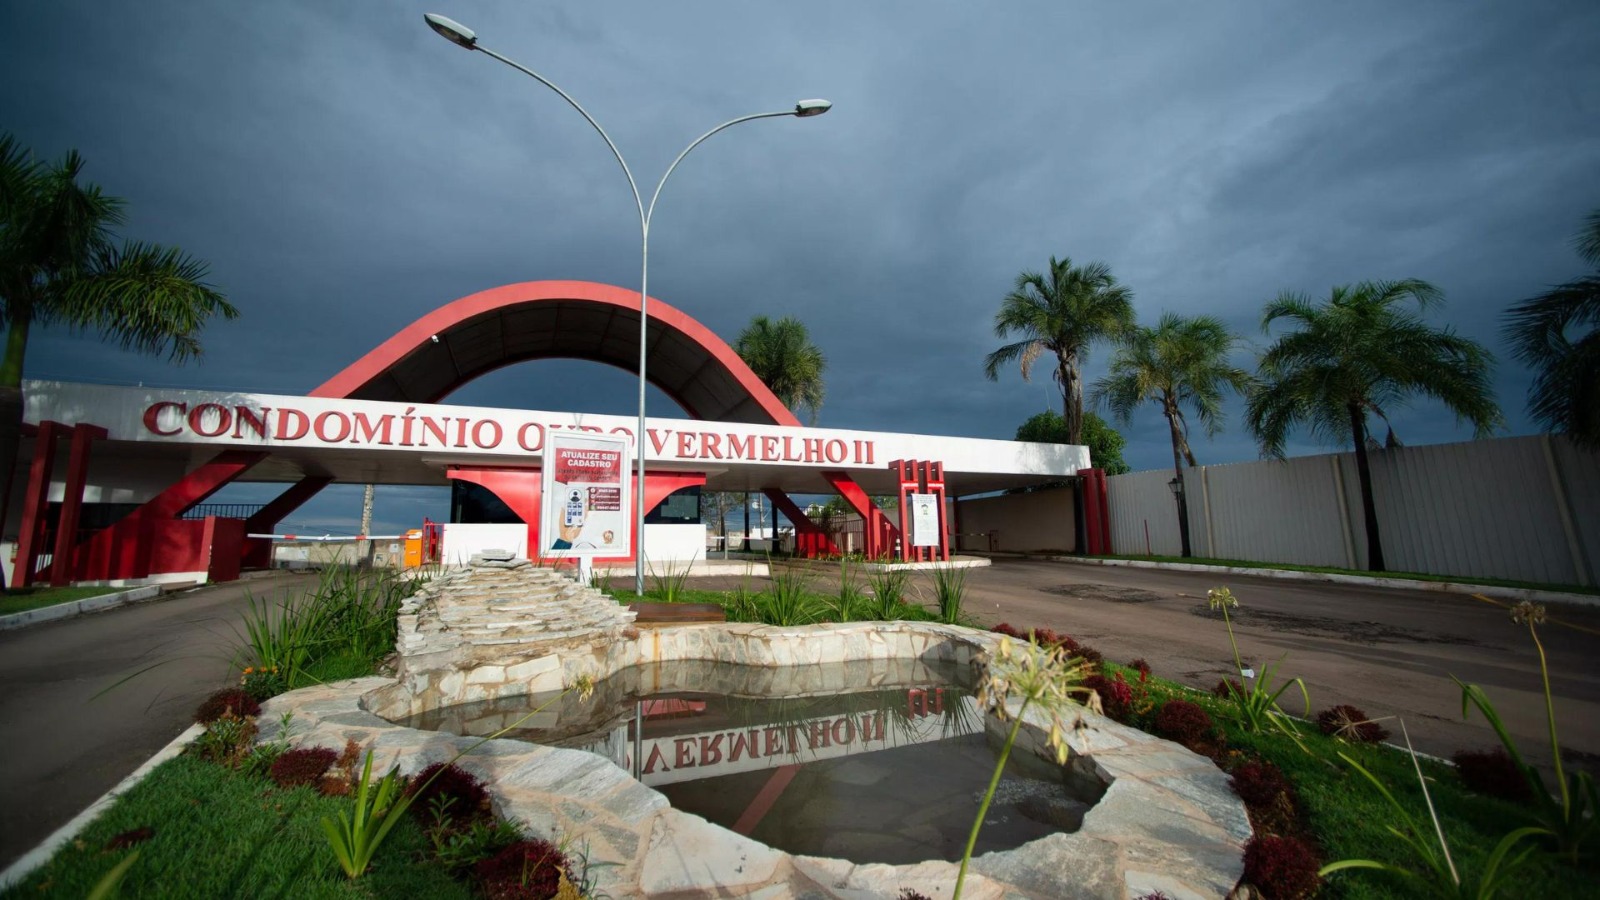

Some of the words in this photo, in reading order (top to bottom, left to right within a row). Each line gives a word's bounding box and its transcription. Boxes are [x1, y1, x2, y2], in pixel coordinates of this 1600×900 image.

[143, 401, 503, 449] CONDOMÍNIO
[646, 428, 849, 464] VERMELHO
[853, 440, 874, 465] II
[561, 451, 600, 460] ATUALIZE
[601, 453, 618, 461] SEU
[567, 459, 612, 468] CADASTRO
